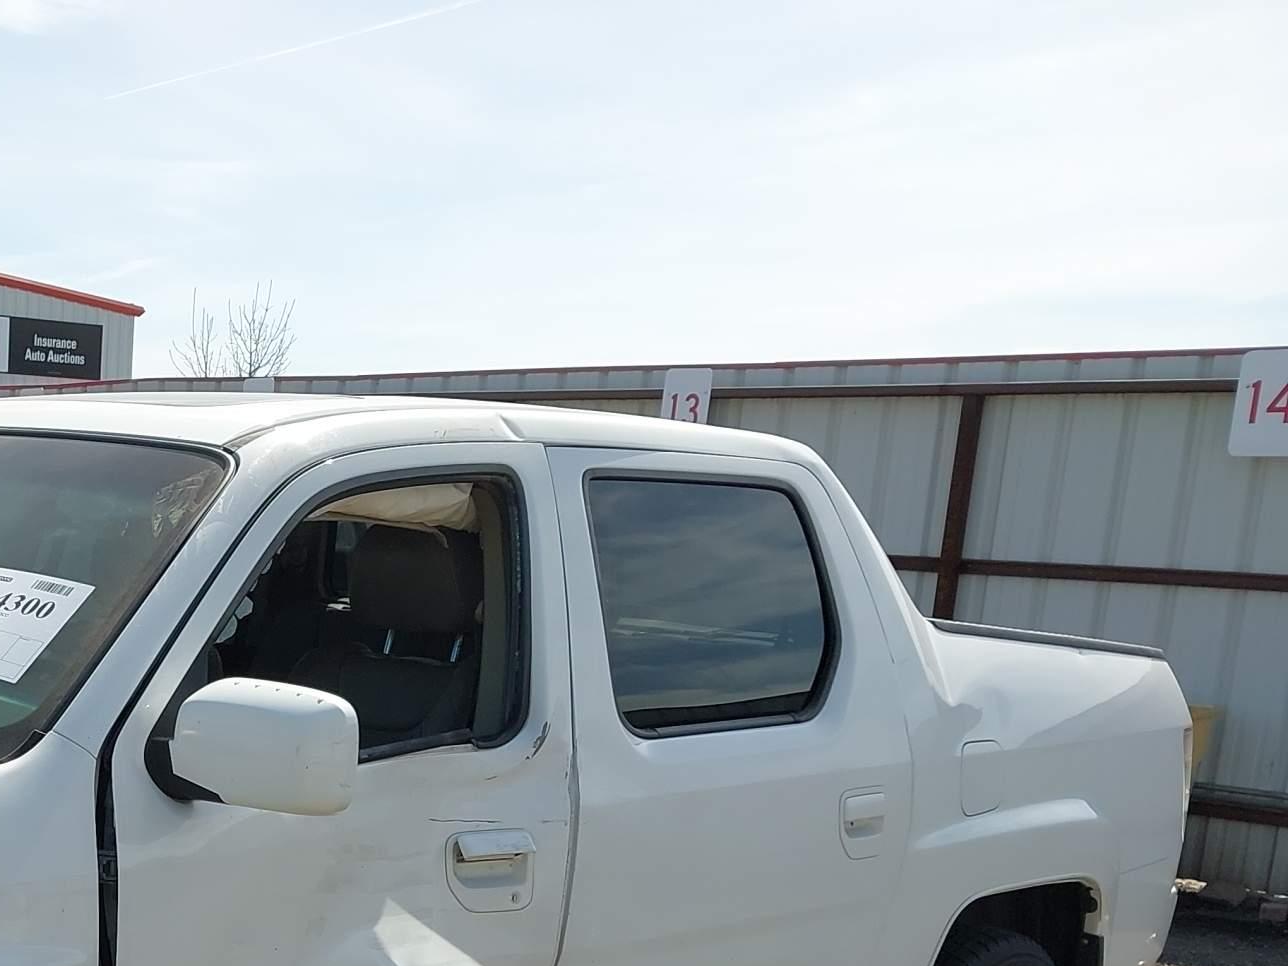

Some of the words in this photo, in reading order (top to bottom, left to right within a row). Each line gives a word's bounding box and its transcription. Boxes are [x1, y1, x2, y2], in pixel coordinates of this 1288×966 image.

[34, 334, 77, 349] Insurance
[25, 348, 45, 362] Auto
[47, 350, 85, 365] Auctions
[670, 393, 700, 423] 13
[1248, 380, 1288, 424] 14
